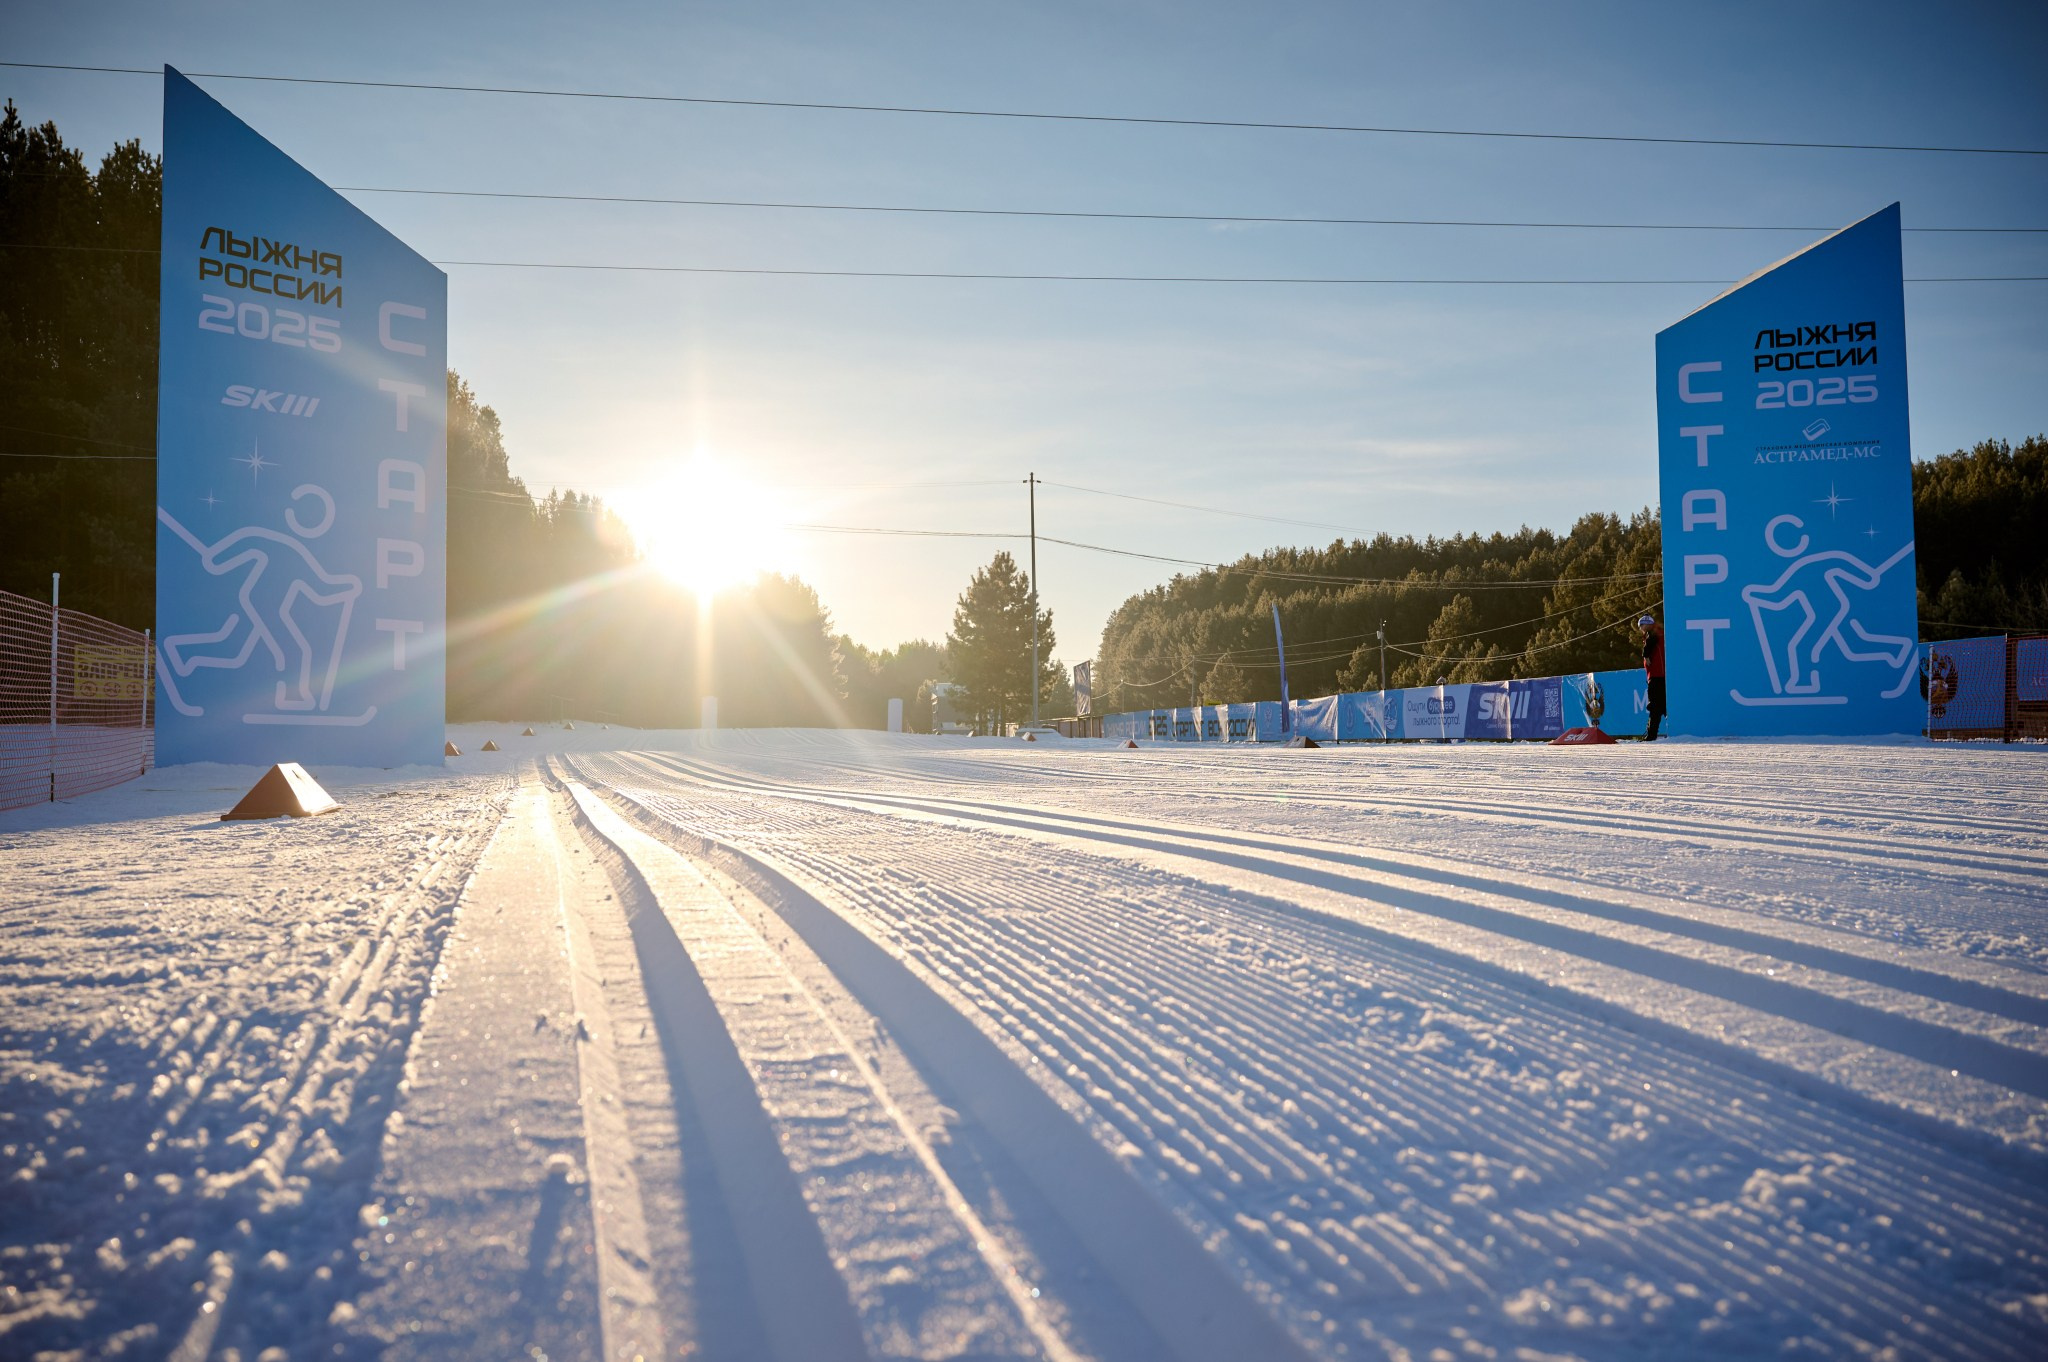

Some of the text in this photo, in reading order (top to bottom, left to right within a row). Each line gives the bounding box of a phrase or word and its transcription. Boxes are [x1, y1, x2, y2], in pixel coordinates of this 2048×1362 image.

[200, 226, 342, 279] ЛЫЖНЯ
[199, 256, 342, 308] РОССИИ
[198, 293, 342, 353] 2025
[1754, 320, 1876, 350] ЛЫЖНЯ
[1754, 346, 1877, 373] РОССИИ
[1755, 374, 1879, 409] 2025
[1753, 445, 1881, 464] АСТРАМЕД-МС
[376, 301, 426, 671] СТАРТ
[1678, 361, 1730, 661] СТАРТ
[1437, 713, 1461, 728] сорта!
